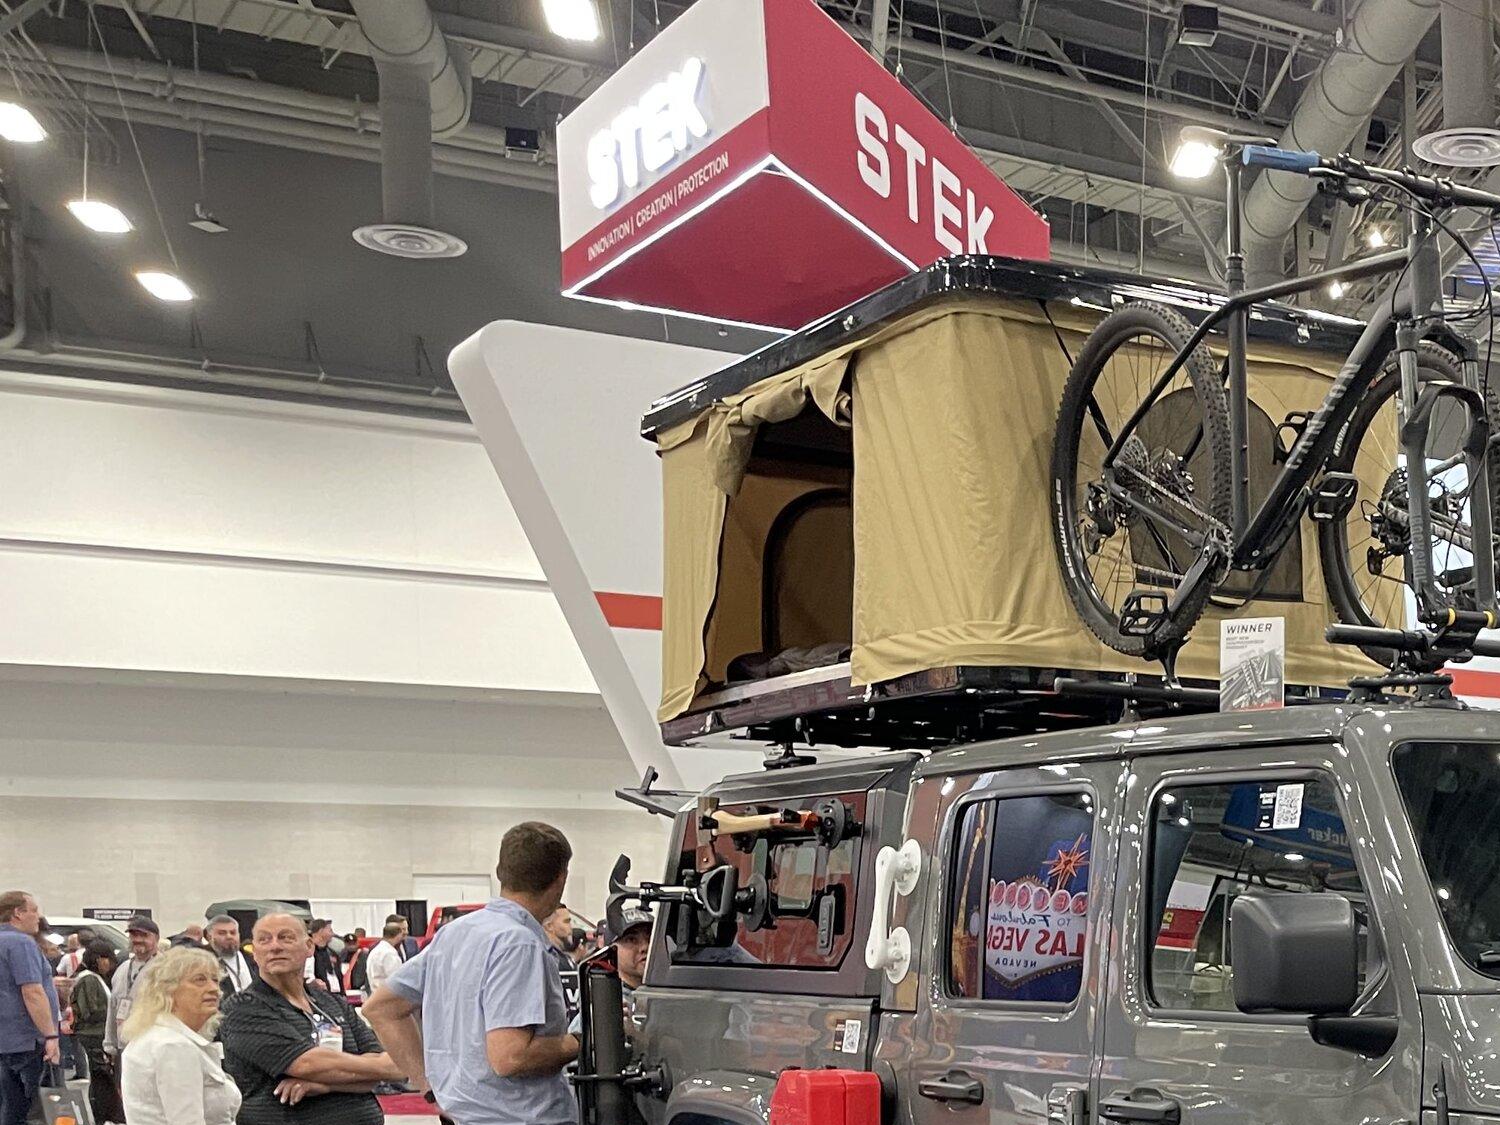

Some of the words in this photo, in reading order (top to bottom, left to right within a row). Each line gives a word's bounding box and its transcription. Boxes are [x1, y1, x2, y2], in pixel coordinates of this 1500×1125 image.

[587, 56, 708, 210] STEK
[855, 91, 995, 255] STEK
[587, 221, 631, 262] INNOVATION
[636, 191, 673, 228] CREATION
[678, 151, 729, 201] PROTECTION
[1226, 623, 1273, 634] WINNER
